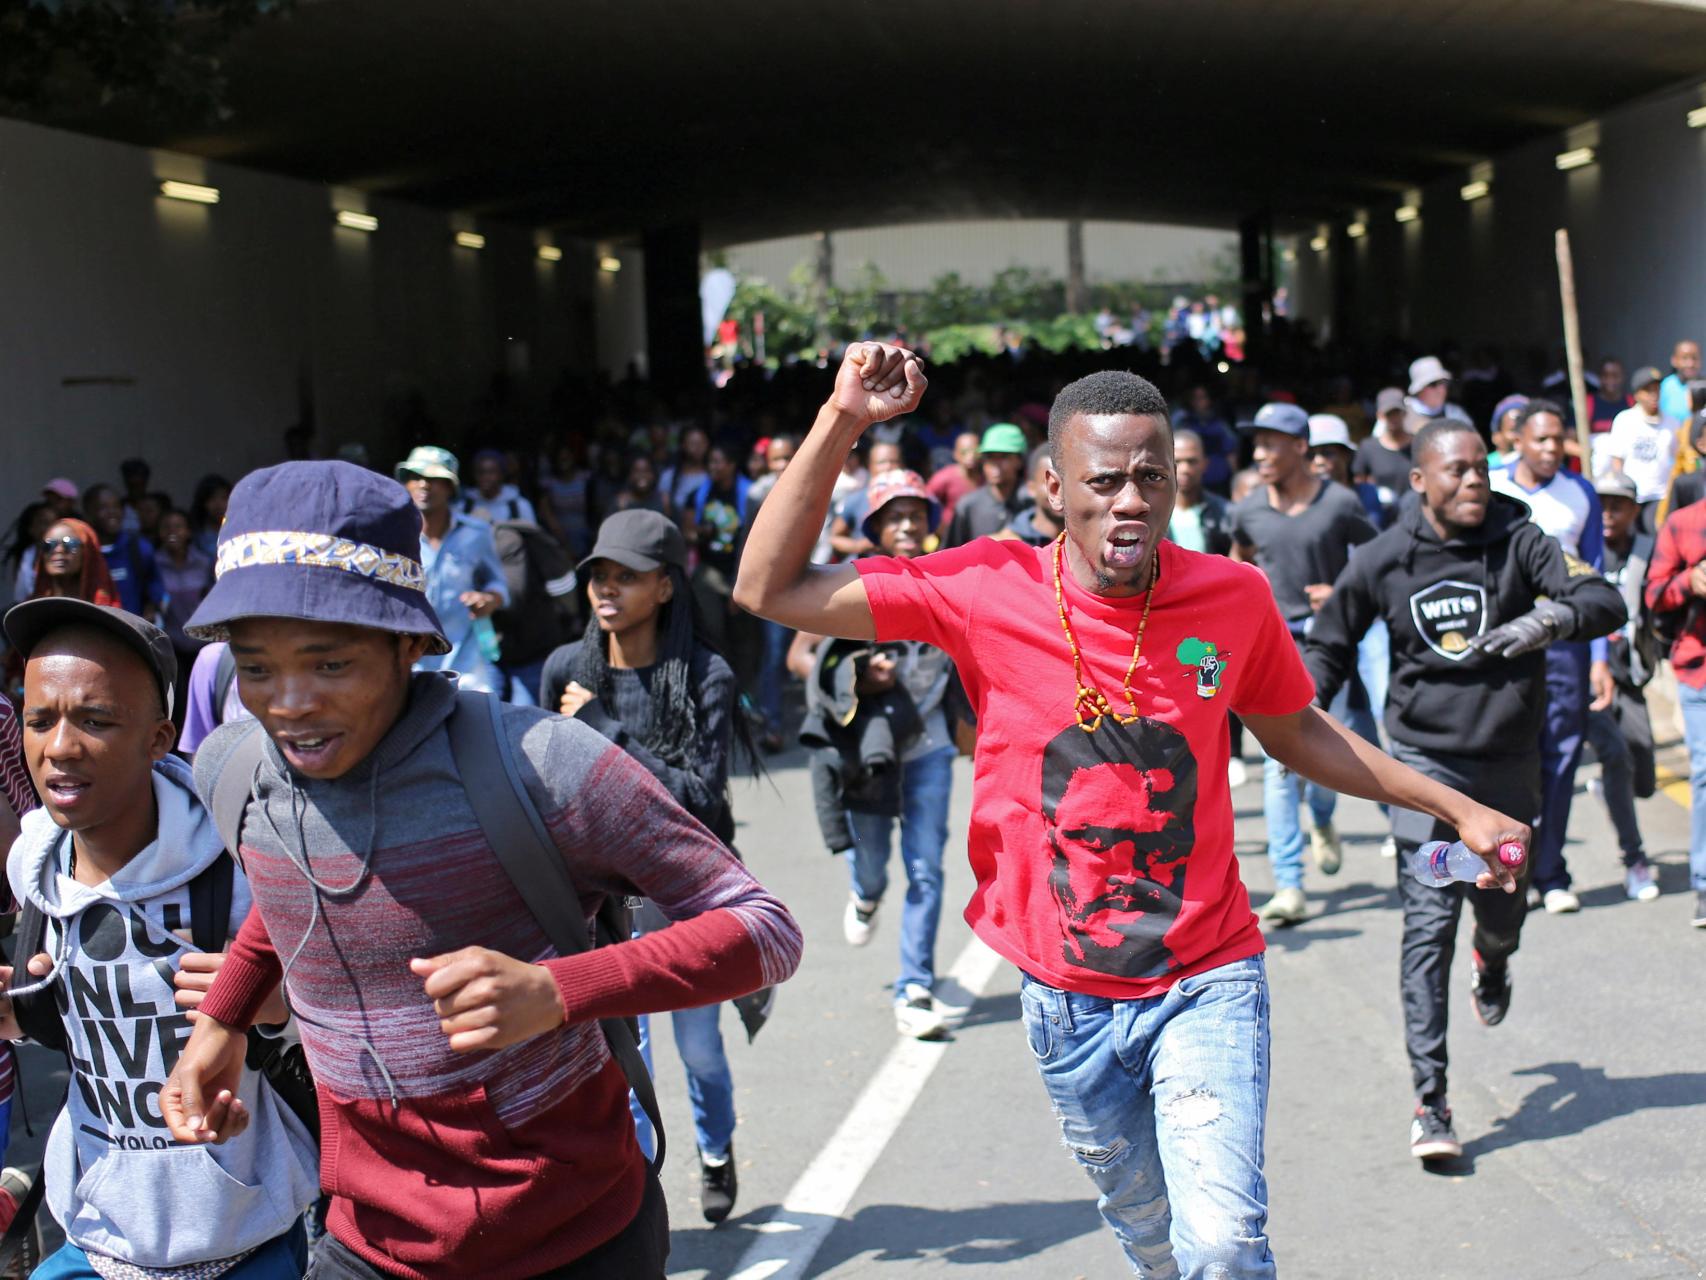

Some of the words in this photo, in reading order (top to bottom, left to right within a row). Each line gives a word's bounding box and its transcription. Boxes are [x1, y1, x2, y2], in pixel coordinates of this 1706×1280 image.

[1420, 595, 1477, 620] WITS
[75, 1070, 170, 1128] ONC
[114, 1135, 168, 1150] YOLO
